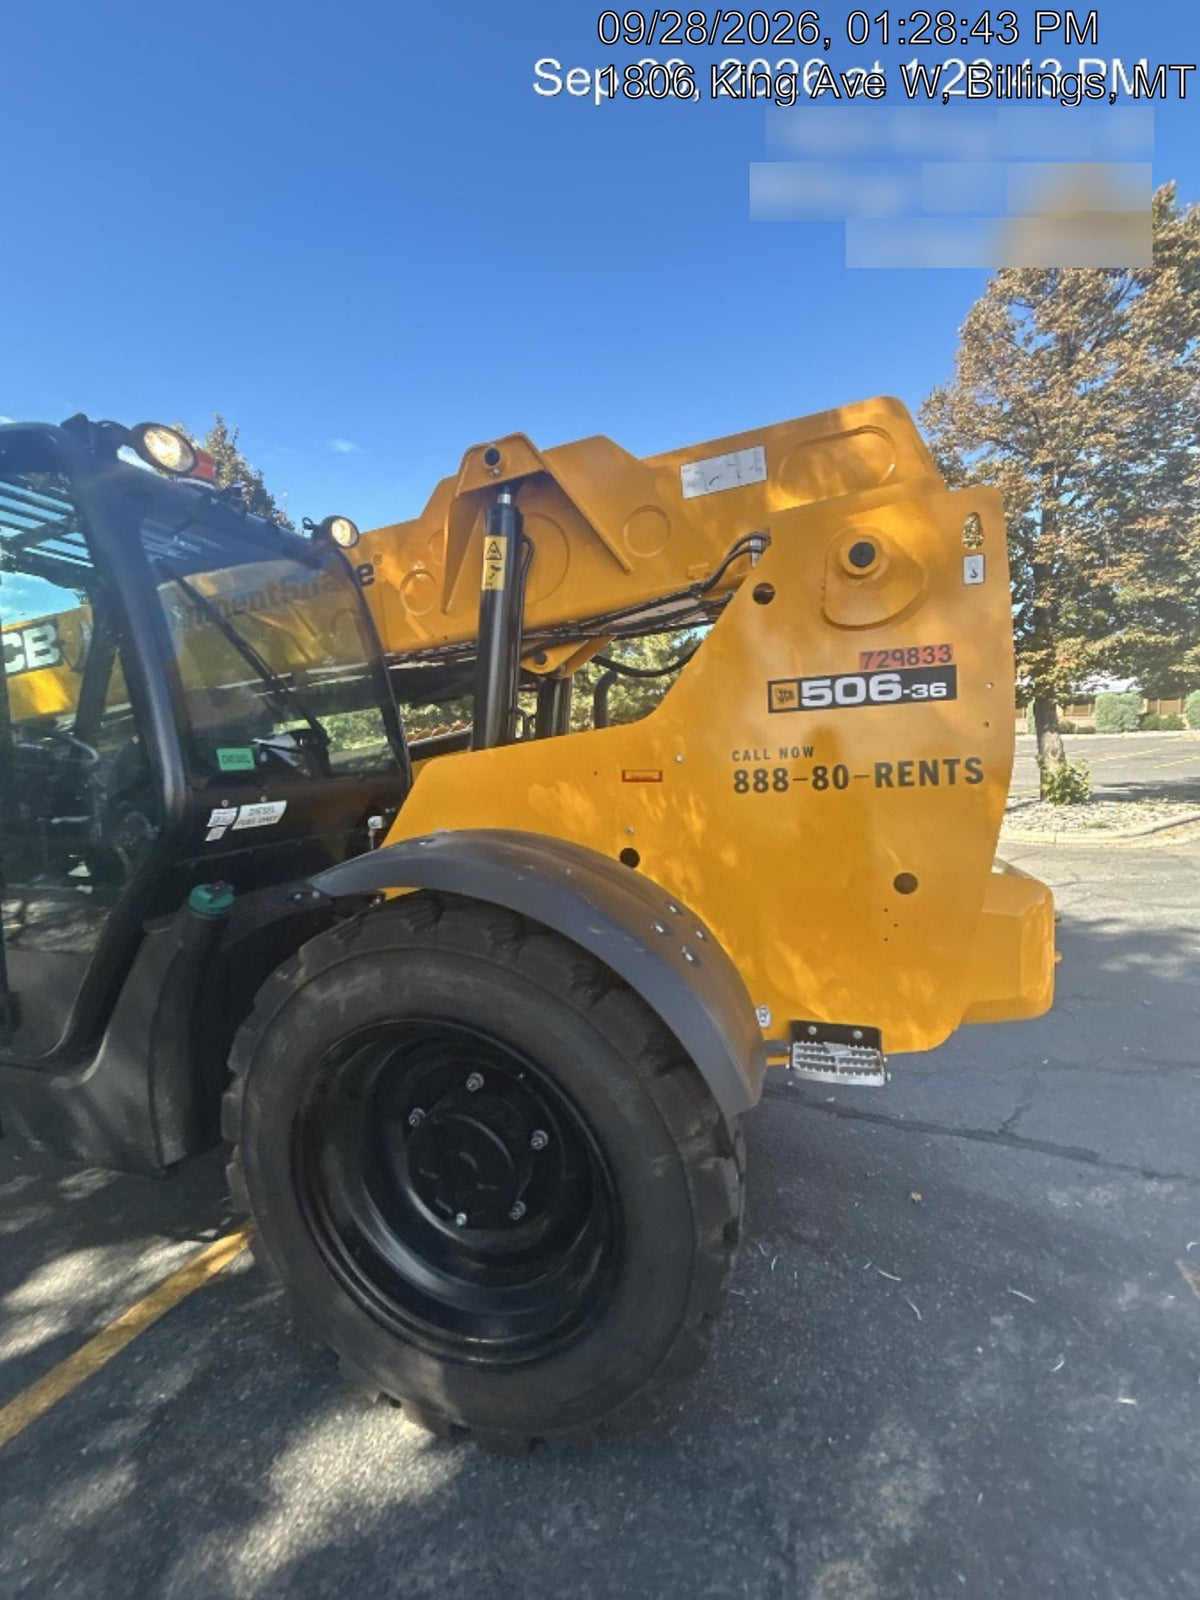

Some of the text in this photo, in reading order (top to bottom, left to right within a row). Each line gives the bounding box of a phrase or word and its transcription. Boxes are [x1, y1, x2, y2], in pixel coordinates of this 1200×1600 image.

[2, 624, 60, 674] CB
[861, 643, 953, 670] 729833
[800, 672, 948, 708] 506-36
[732, 746, 815, 762] CALL NOW
[733, 756, 985, 794] 888-80-RENTS
